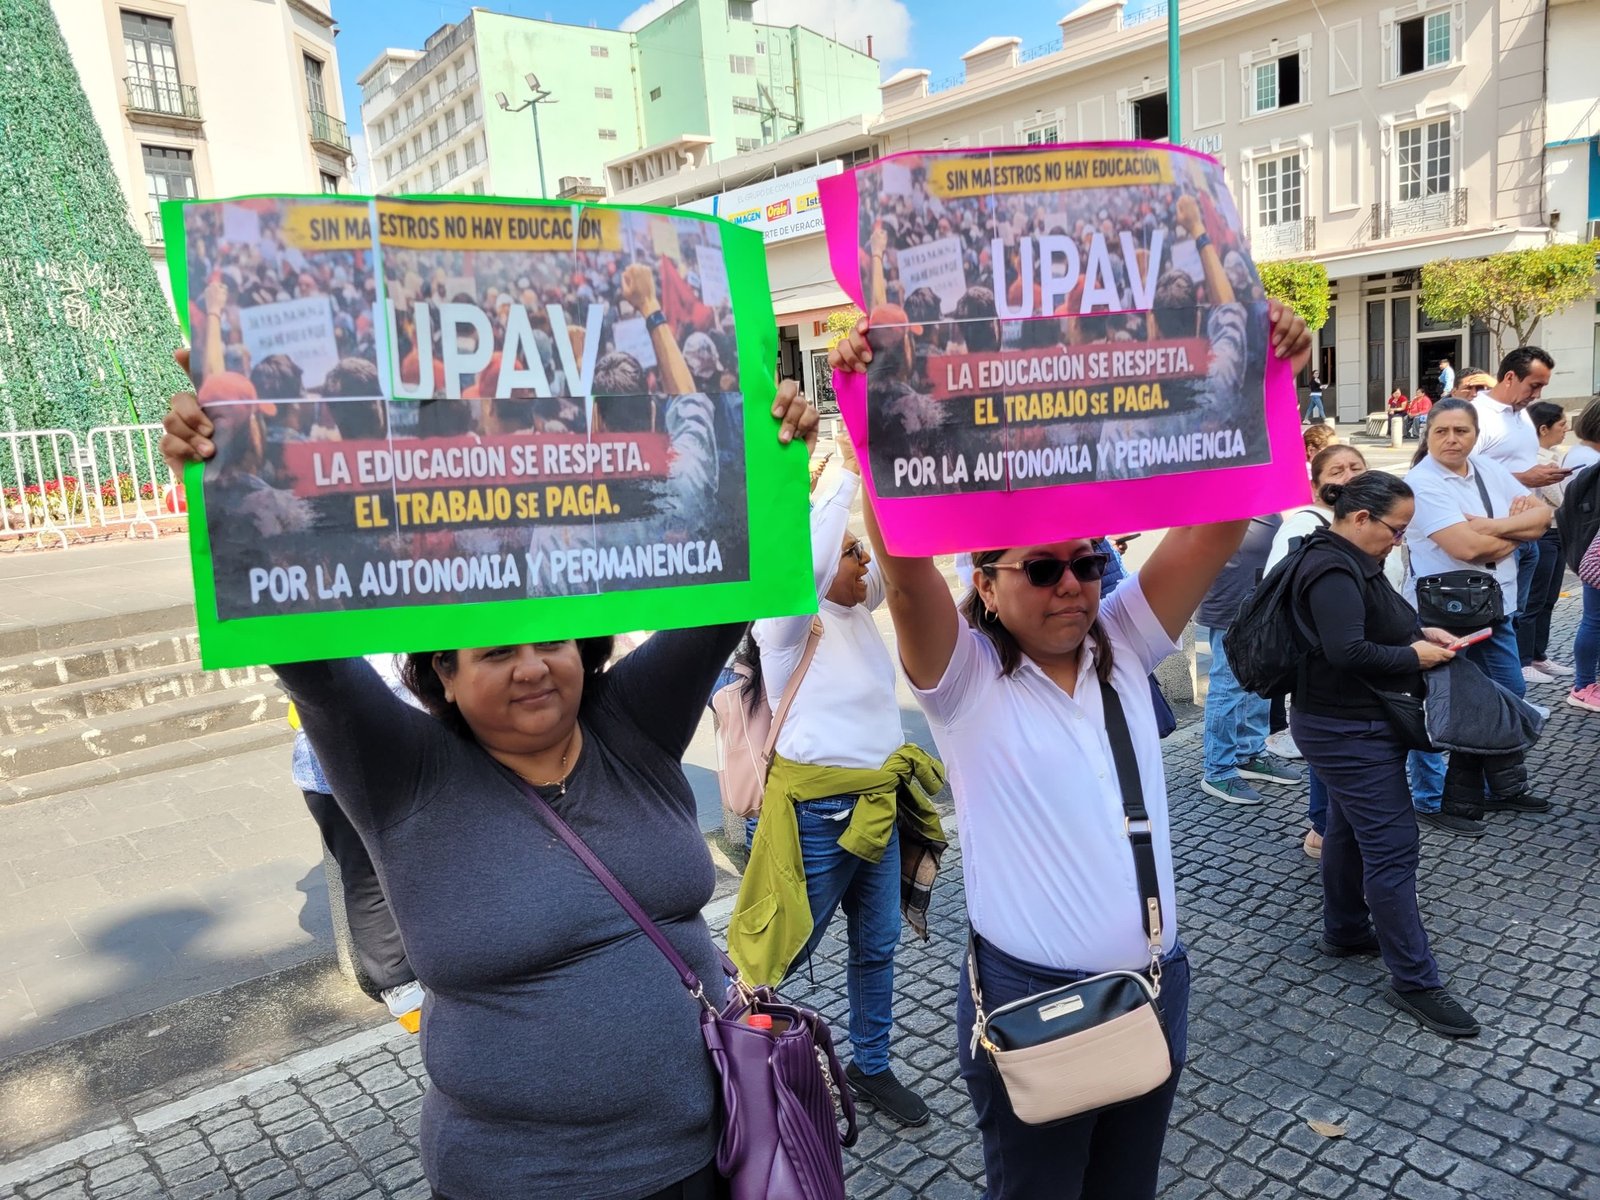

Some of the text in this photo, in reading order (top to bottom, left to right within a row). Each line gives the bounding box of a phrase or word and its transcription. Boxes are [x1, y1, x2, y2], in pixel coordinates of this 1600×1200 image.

[946, 154, 1160, 191] SIN MAESTROS NO HAY EDUCACIÓN
[310, 213, 603, 241] SIN MAESTROS NO HAY EDUCACIÓN
[779, 225, 789, 236] DE
[991, 229, 1164, 319] UPAV
[372, 298, 604, 400] UPAV
[947, 362, 973, 391] LA
[1088, 351, 1109, 379] SE
[1112, 347, 1194, 378] RESPETA.
[974, 383, 1169, 425] EL TRABAJO SE PAGA.
[313, 451, 352, 486] LA
[511, 444, 539, 476] SE
[543, 442, 650, 475] RESPETA.
[894, 428, 1246, 487] POR LA AUTONOMIA Y PERMANENCIA
[354, 484, 620, 528] EL TRABAJO SE PAGA.
[249, 539, 723, 603] POR LA AUTONOMIA Y PERMANENCIA
